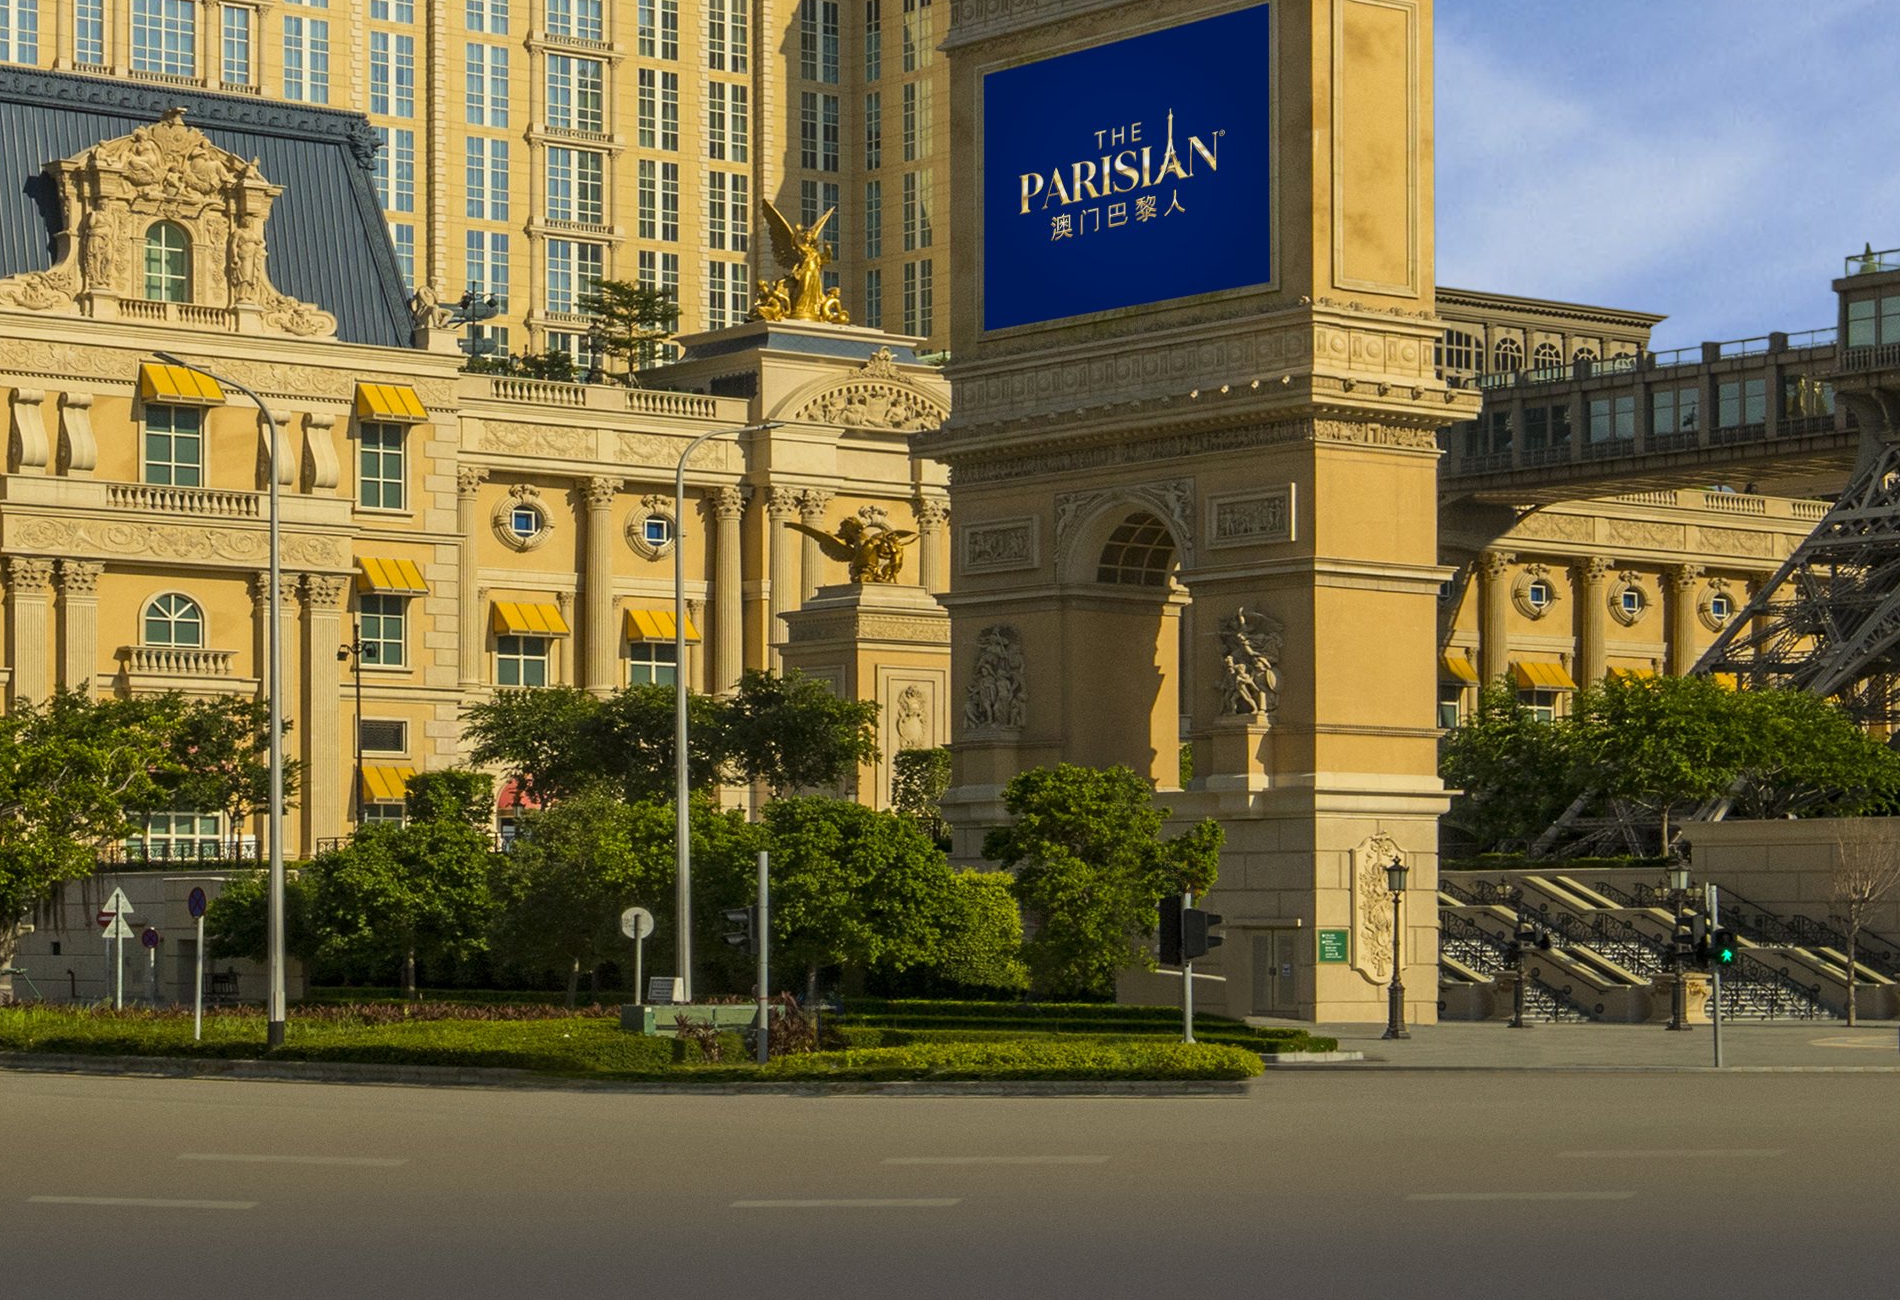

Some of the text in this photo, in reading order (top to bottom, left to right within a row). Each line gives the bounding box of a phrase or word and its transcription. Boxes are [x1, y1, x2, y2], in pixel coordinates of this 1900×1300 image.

[1094, 122, 1142, 150] THE
[1050, 188, 1186, 241] 澳门巴黎人
